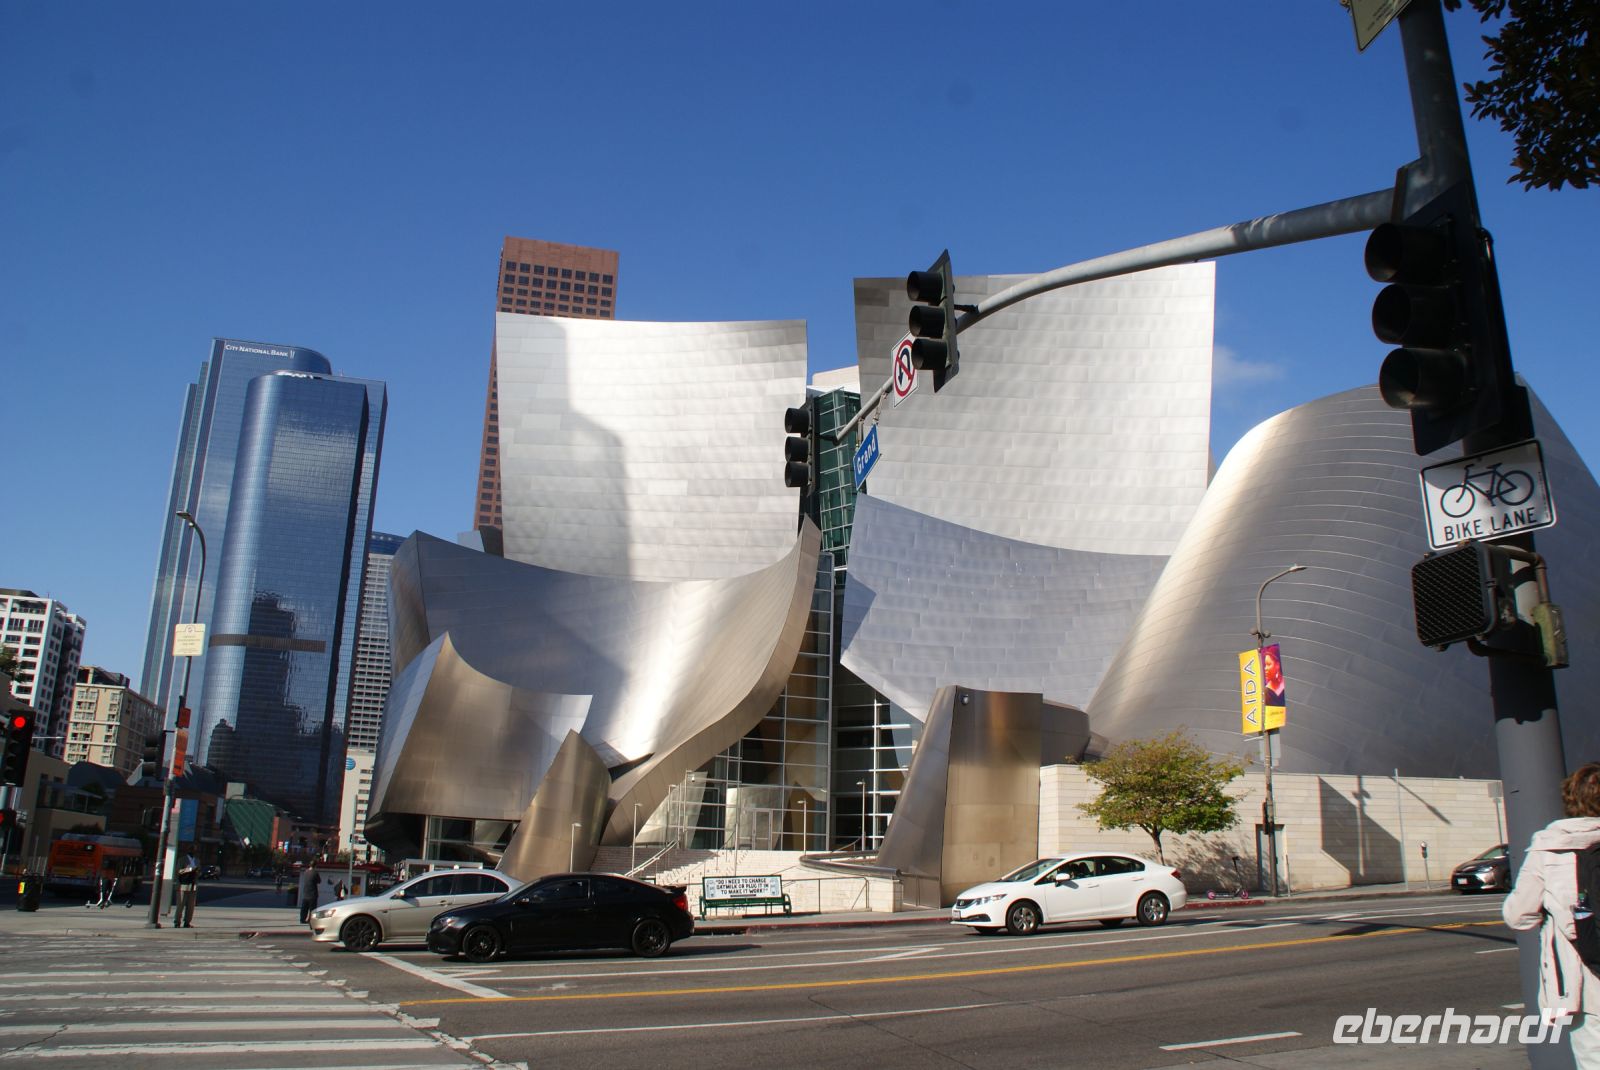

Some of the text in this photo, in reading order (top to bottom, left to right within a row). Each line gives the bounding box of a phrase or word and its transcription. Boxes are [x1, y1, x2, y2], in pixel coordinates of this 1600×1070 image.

[857, 434, 876, 475] Grand
[1444, 507, 1537, 541] BIKE LANE
[1244, 657, 1257, 724] AIDA
